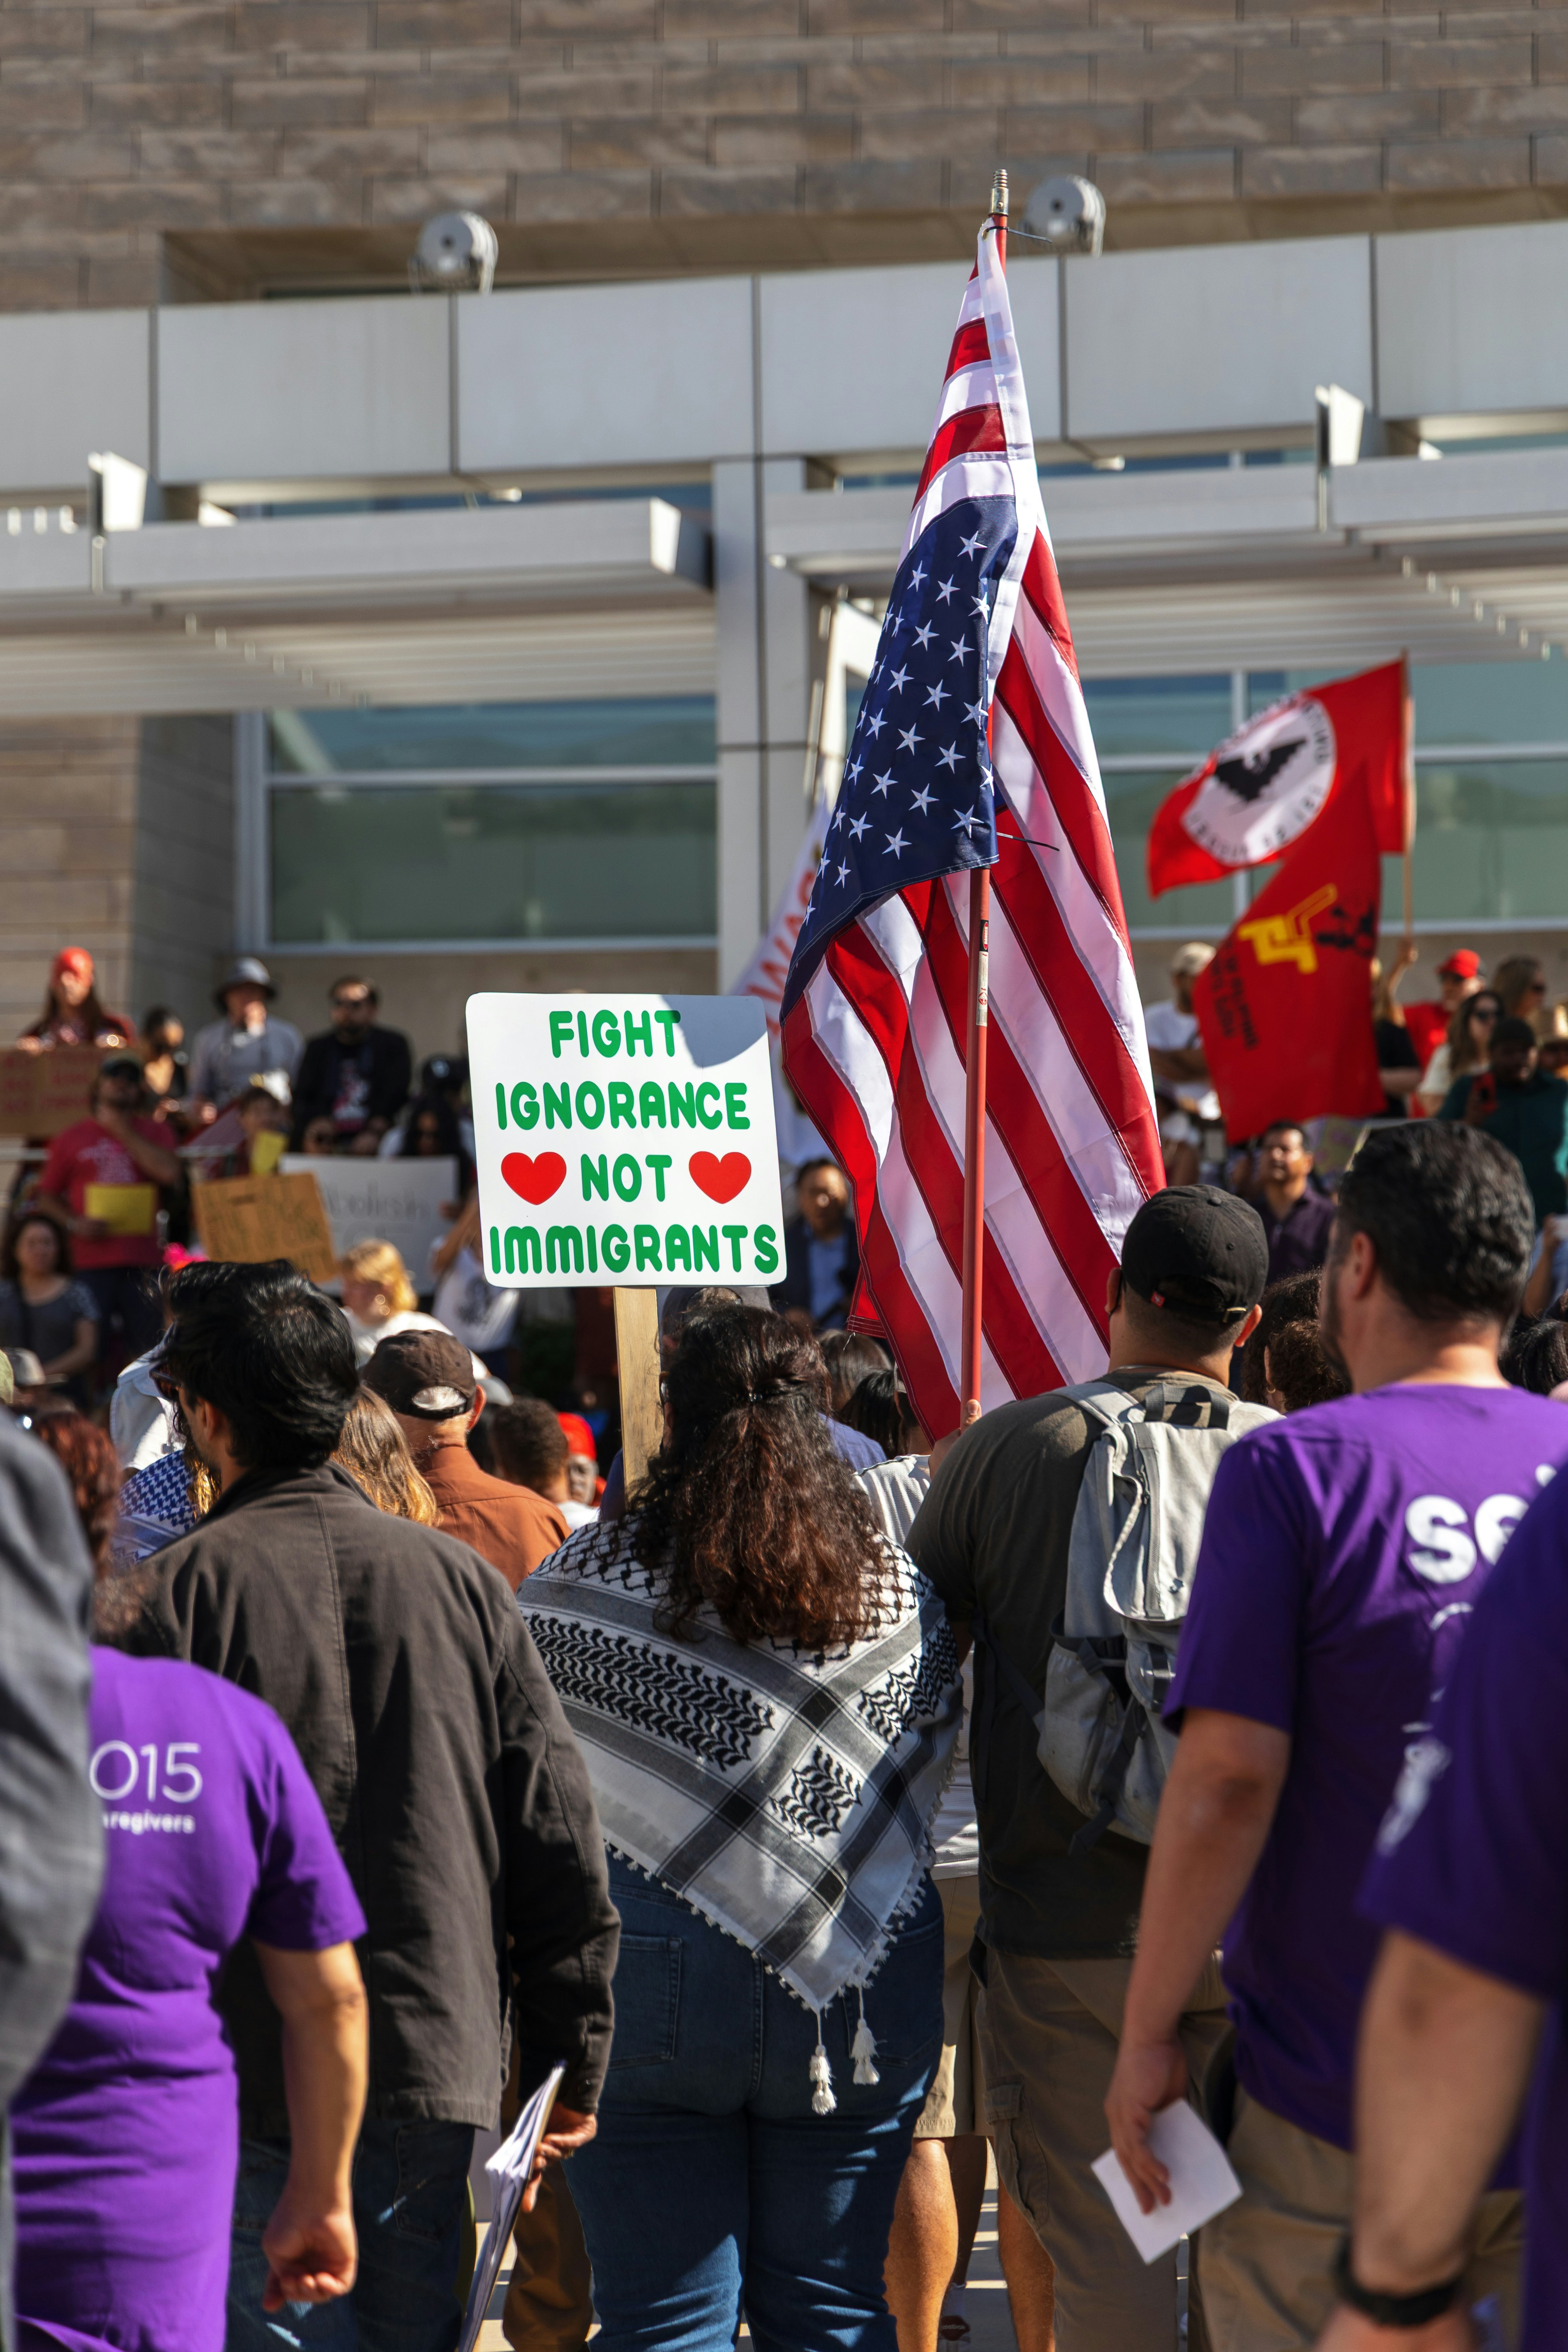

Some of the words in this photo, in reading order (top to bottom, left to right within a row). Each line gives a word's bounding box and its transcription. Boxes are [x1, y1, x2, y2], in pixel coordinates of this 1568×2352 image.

[548, 1009, 681, 1058] FIGHT
[495, 1081, 750, 1130] IGNORANCE
[580, 1153, 672, 1202] NOT
[490, 1223, 779, 1274] IMMIGRANTS
